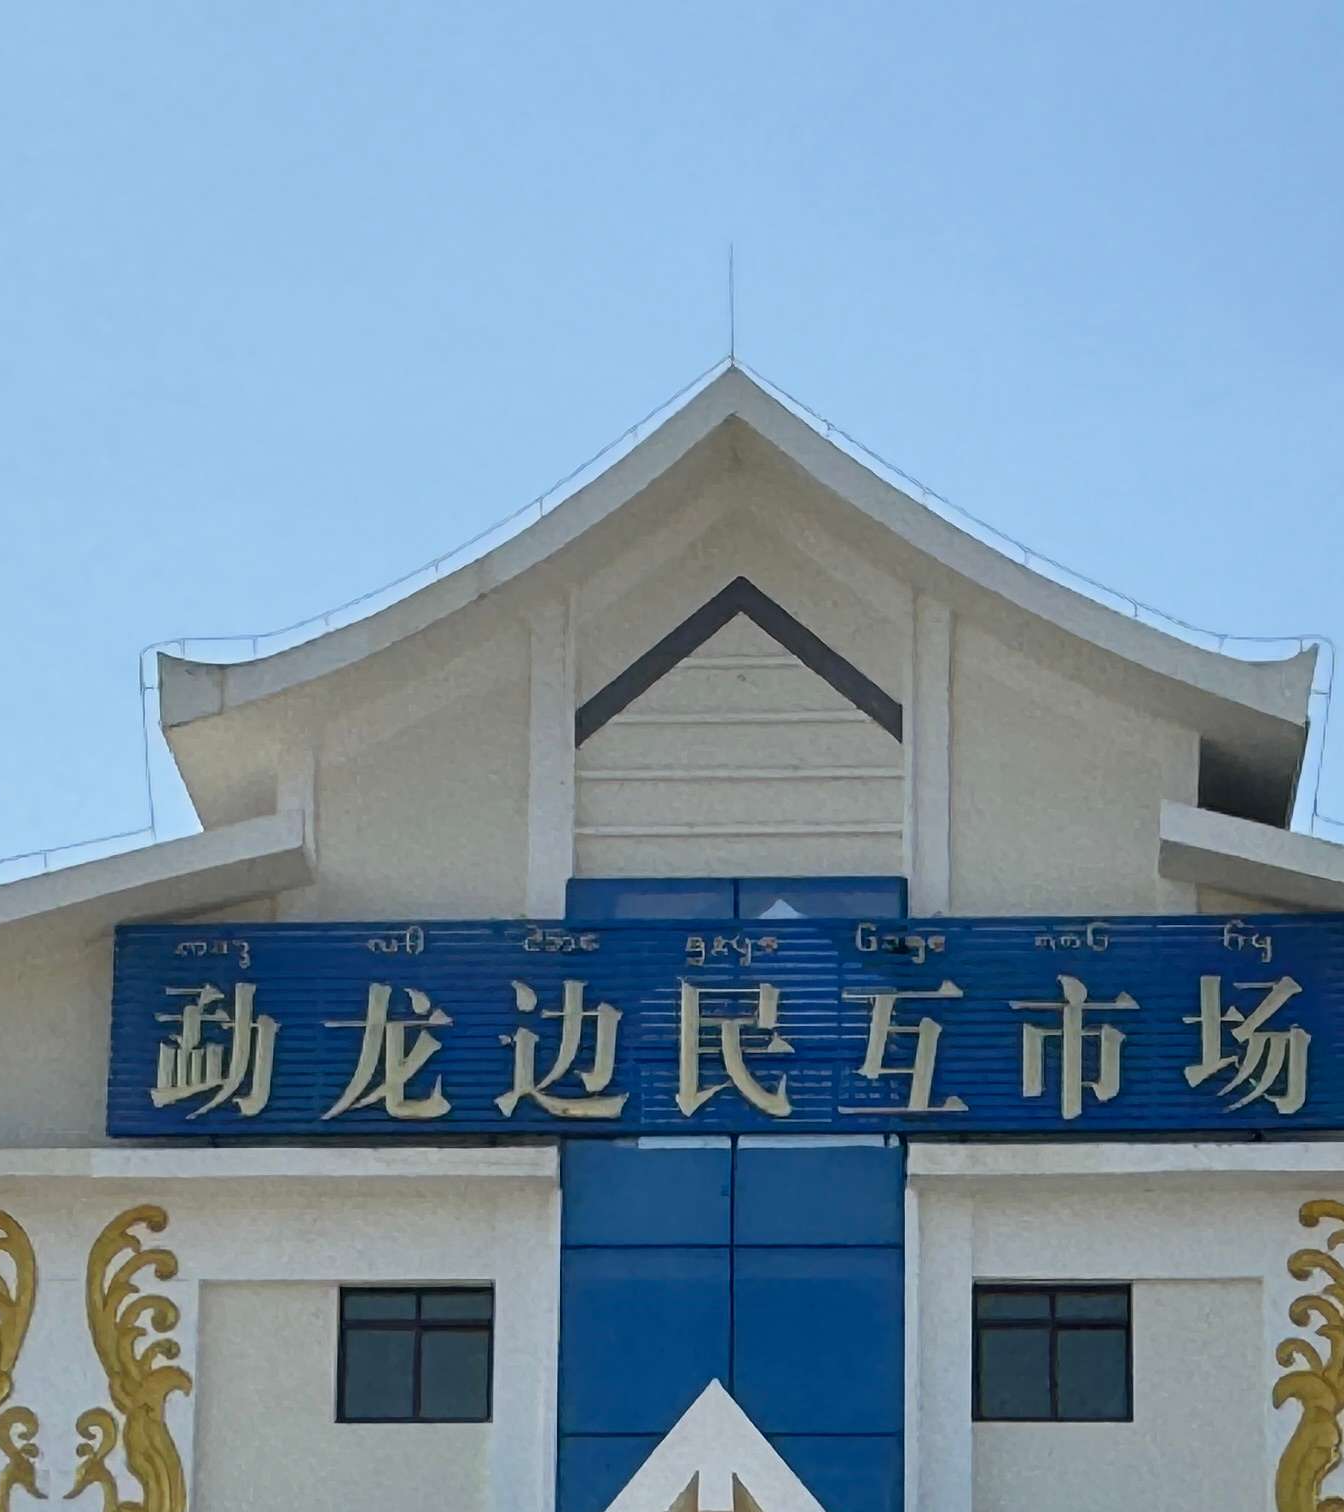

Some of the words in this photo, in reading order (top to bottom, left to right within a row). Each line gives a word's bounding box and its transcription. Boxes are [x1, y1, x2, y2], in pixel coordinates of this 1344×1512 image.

[149, 973, 1312, 1120] 勐龙边民互市场
